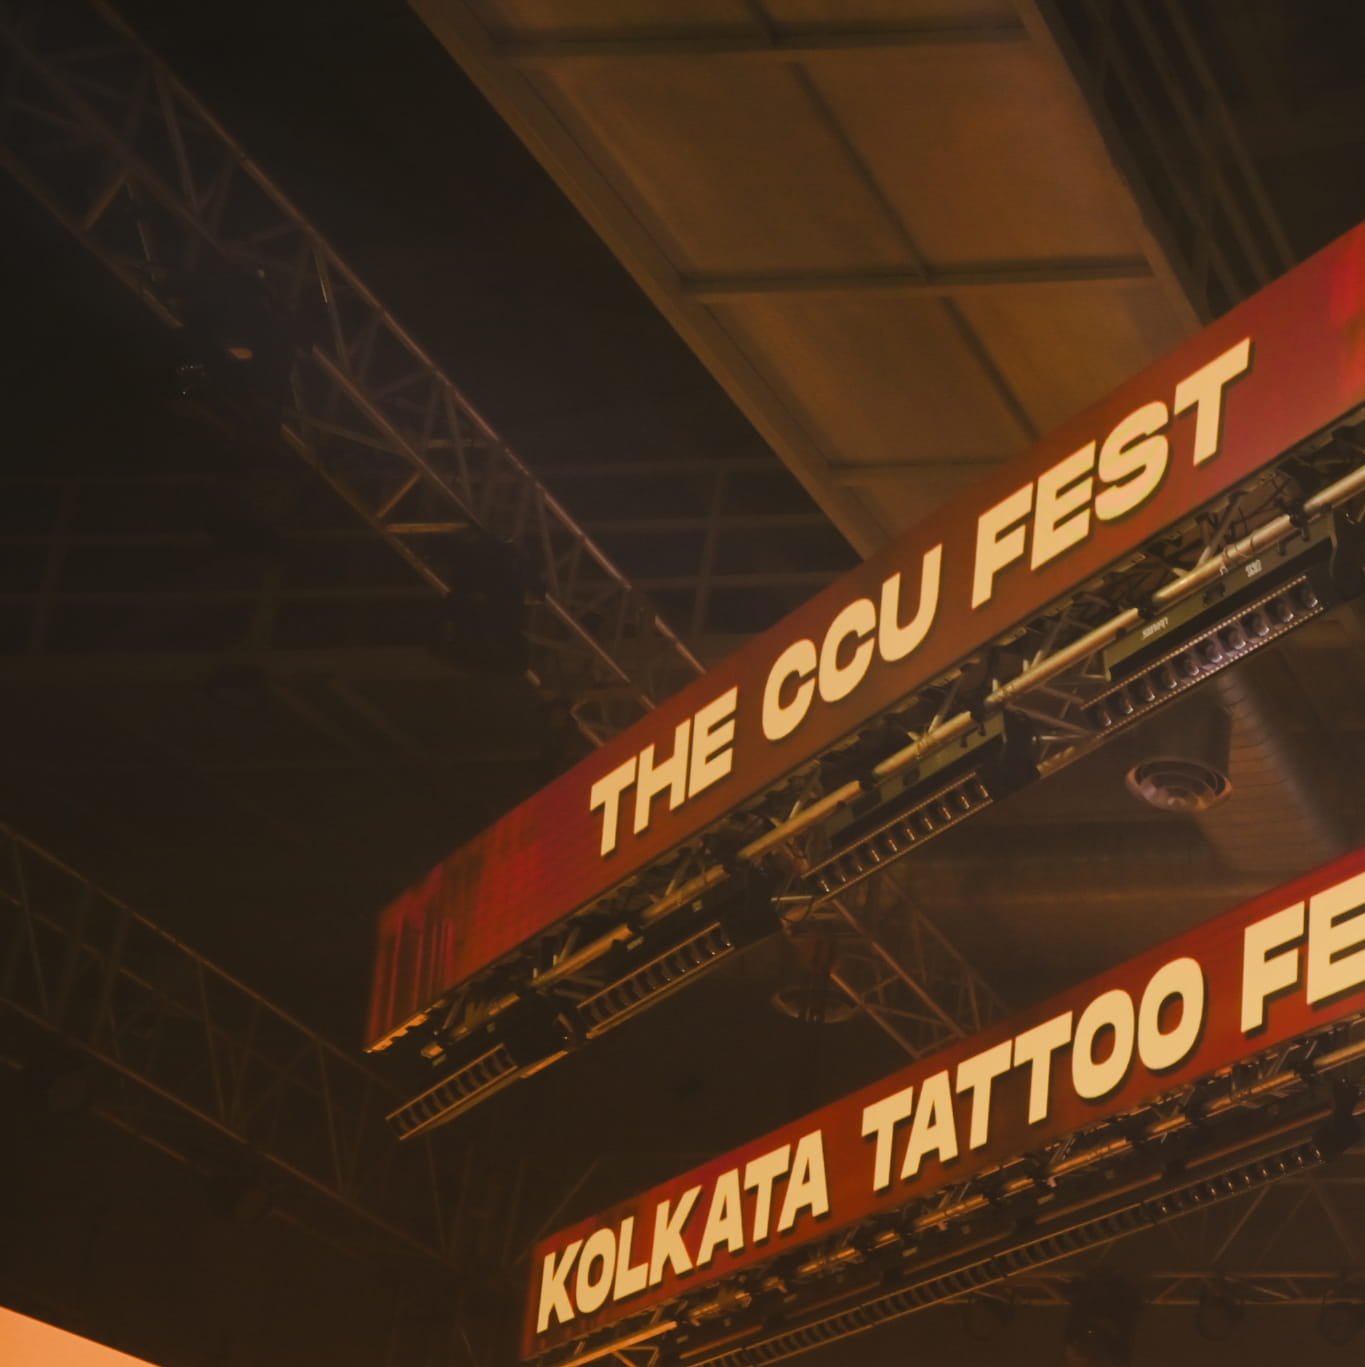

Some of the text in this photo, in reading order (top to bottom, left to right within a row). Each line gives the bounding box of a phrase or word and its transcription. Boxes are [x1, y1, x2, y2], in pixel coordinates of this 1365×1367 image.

[590, 337, 1251, 857] THE CCU FEST
[535, 1129, 829, 1333] KOLKATA
[861, 956, 1204, 1192] TATTOO
